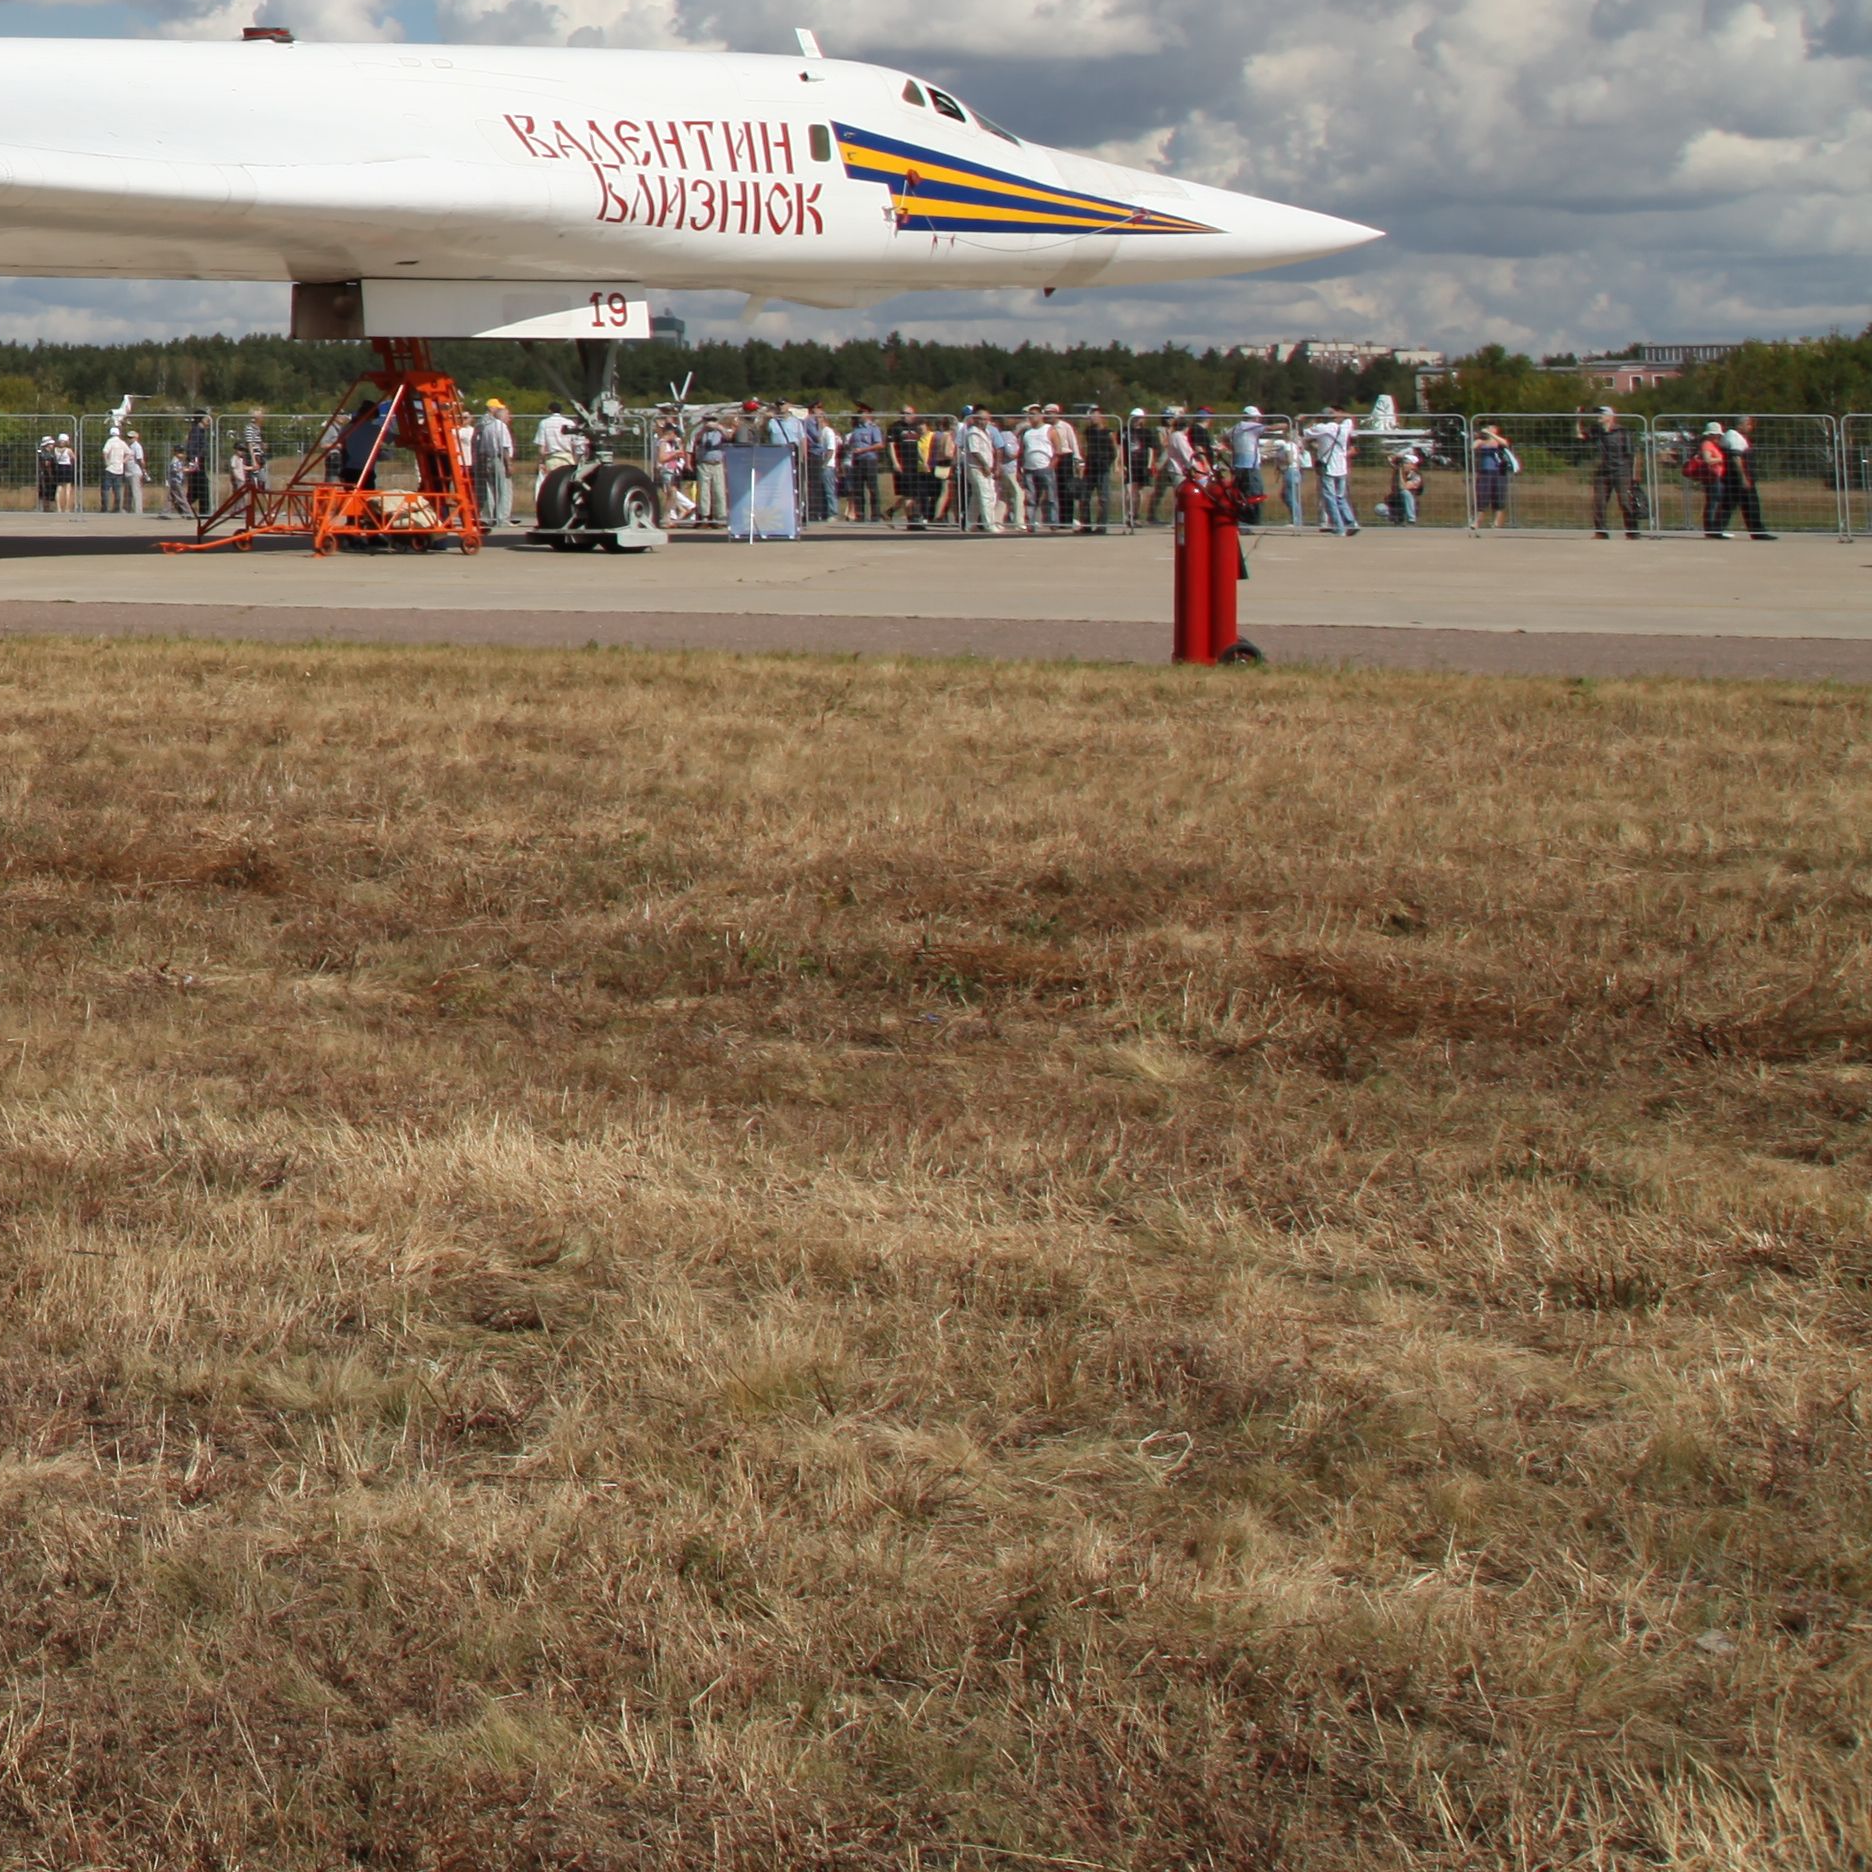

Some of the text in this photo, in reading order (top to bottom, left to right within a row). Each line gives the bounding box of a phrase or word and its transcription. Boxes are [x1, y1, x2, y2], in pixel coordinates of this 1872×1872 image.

[504, 114, 795, 174] ВАЛЕНТИН
[592, 162, 824, 236] БЛИЗНЮК
[588, 291, 629, 328] 19
